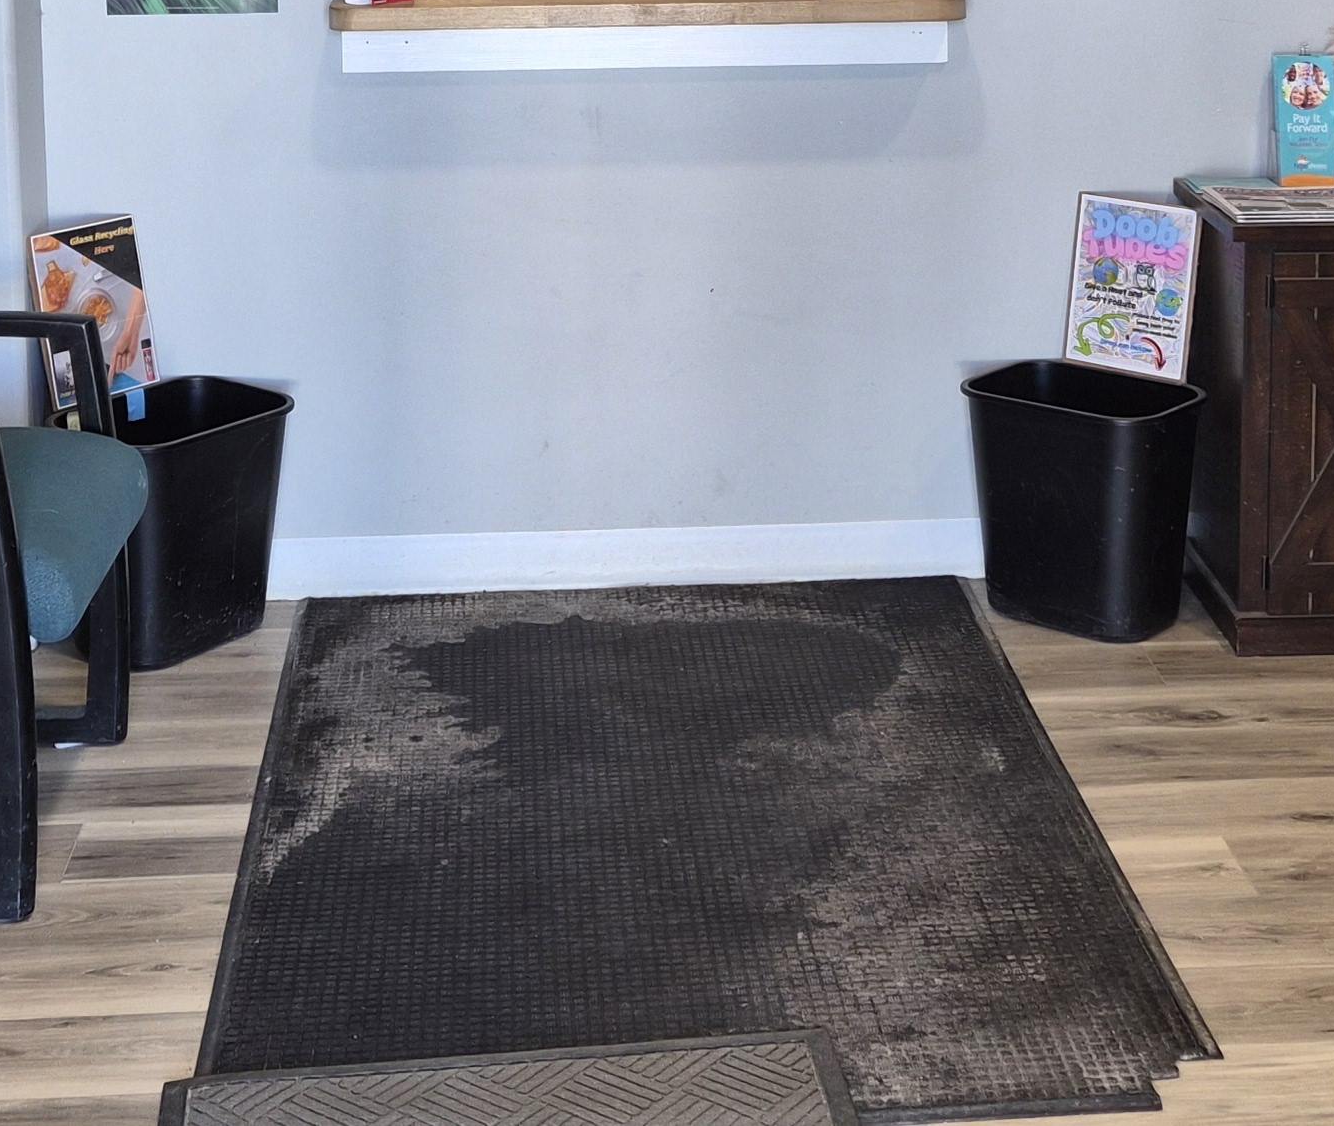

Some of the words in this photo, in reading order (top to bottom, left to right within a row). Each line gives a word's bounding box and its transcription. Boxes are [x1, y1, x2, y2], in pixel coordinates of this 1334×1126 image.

[1292, 114, 1311, 125] Pay
[1287, 123, 1328, 133] Forward
[1092, 209, 1179, 248] Doob
[69, 234, 94, 246] Glass
[94, 226, 134, 241] Recycling
[94, 244, 115, 255] Here
